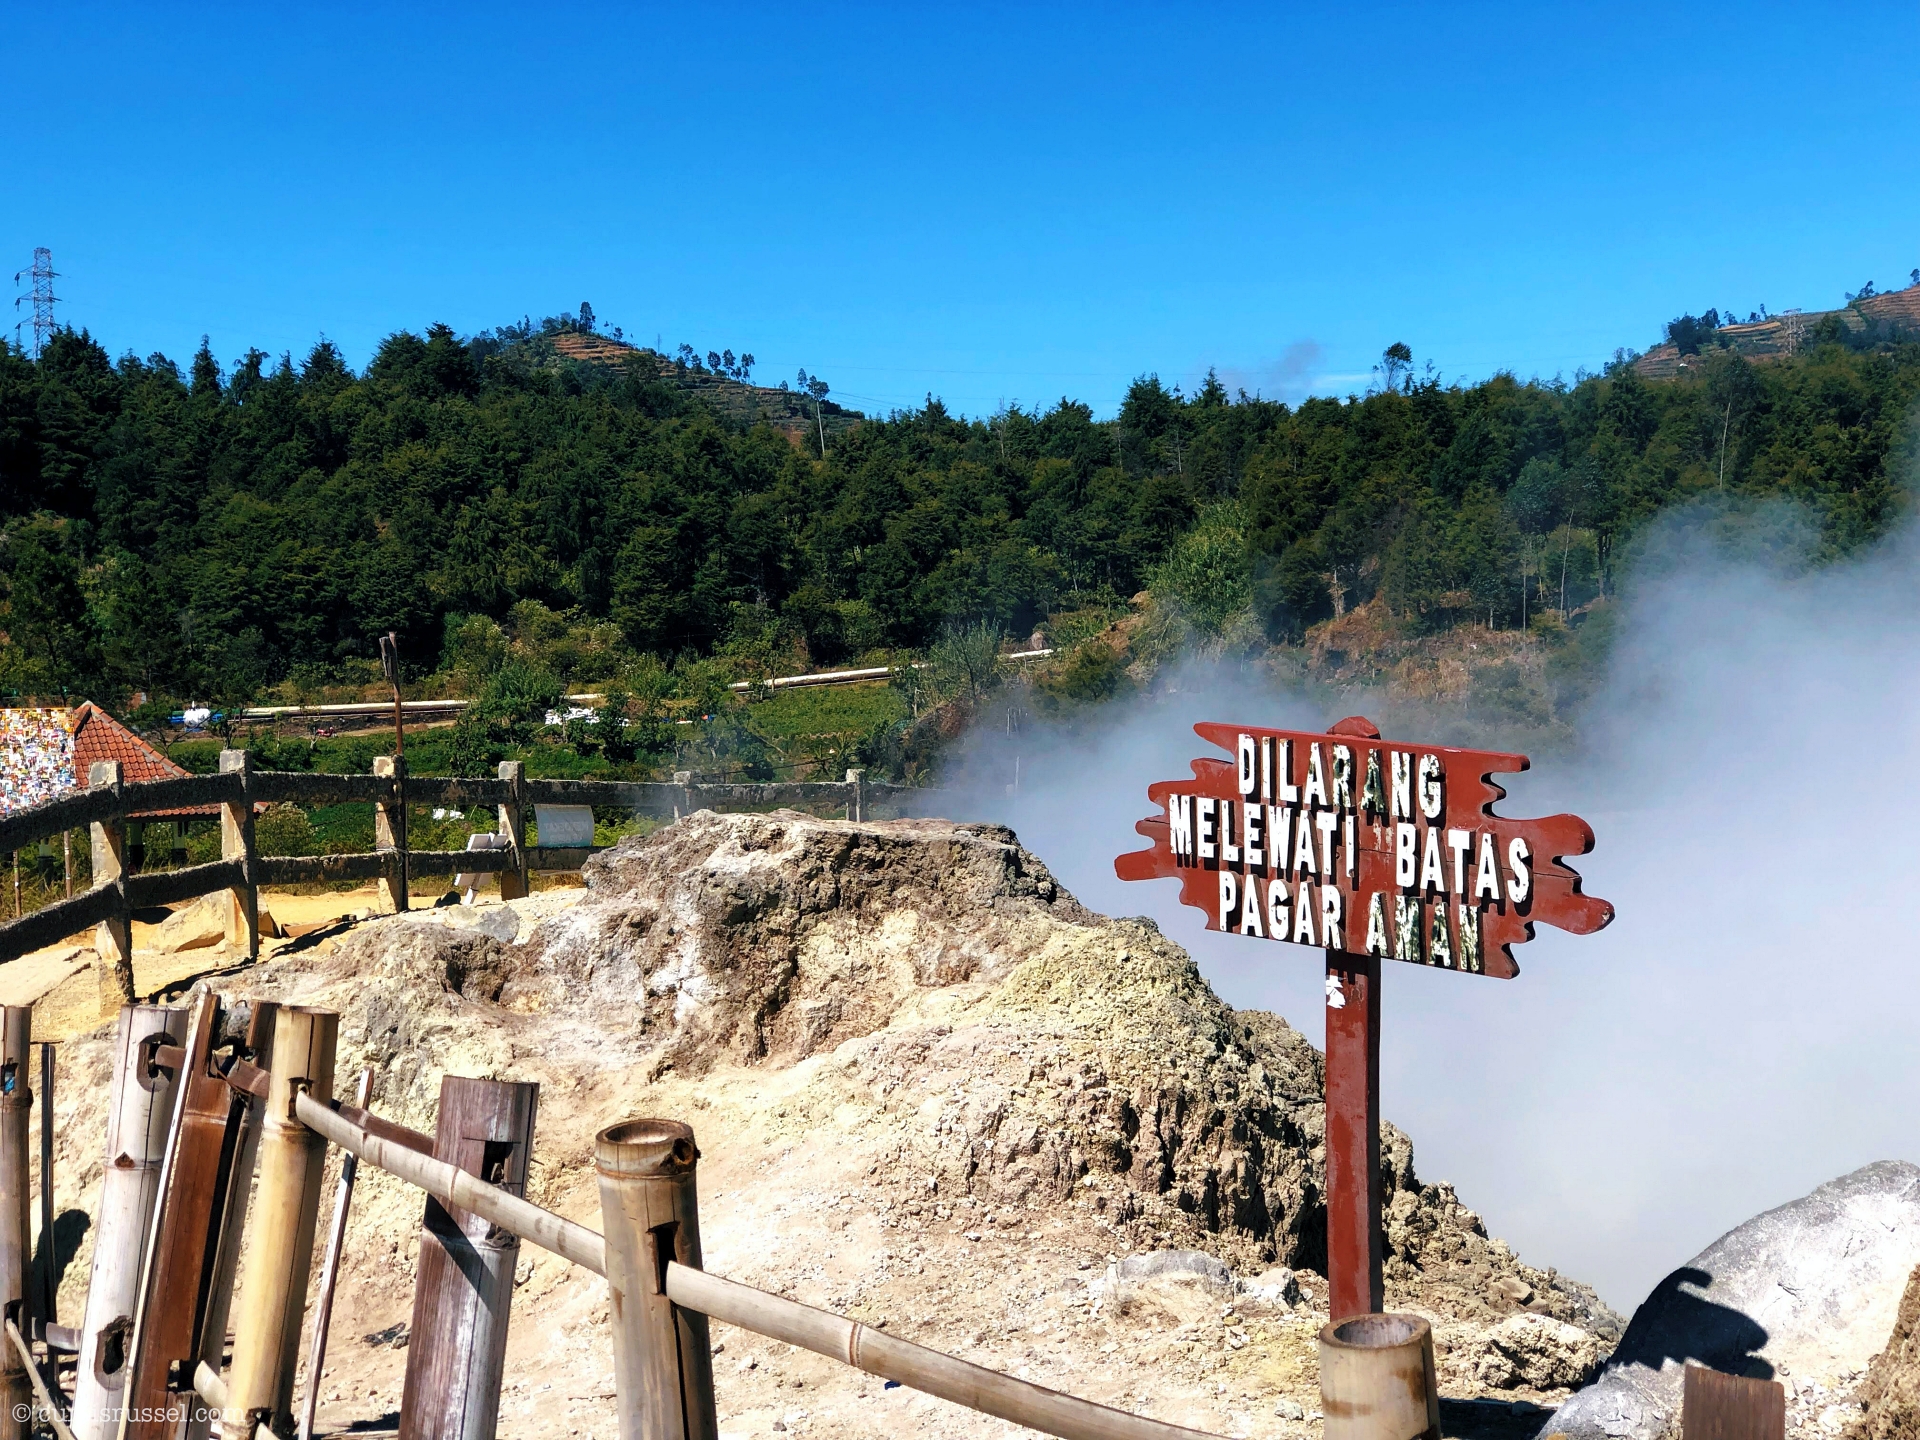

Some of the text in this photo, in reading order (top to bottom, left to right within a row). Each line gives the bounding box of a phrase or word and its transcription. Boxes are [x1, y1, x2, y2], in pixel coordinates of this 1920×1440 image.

[1238, 733, 1442, 818] DILARANG
[1169, 794, 1531, 904] MELEWATI BATAS
[1219, 871, 1481, 972] PAGAR AMAN
